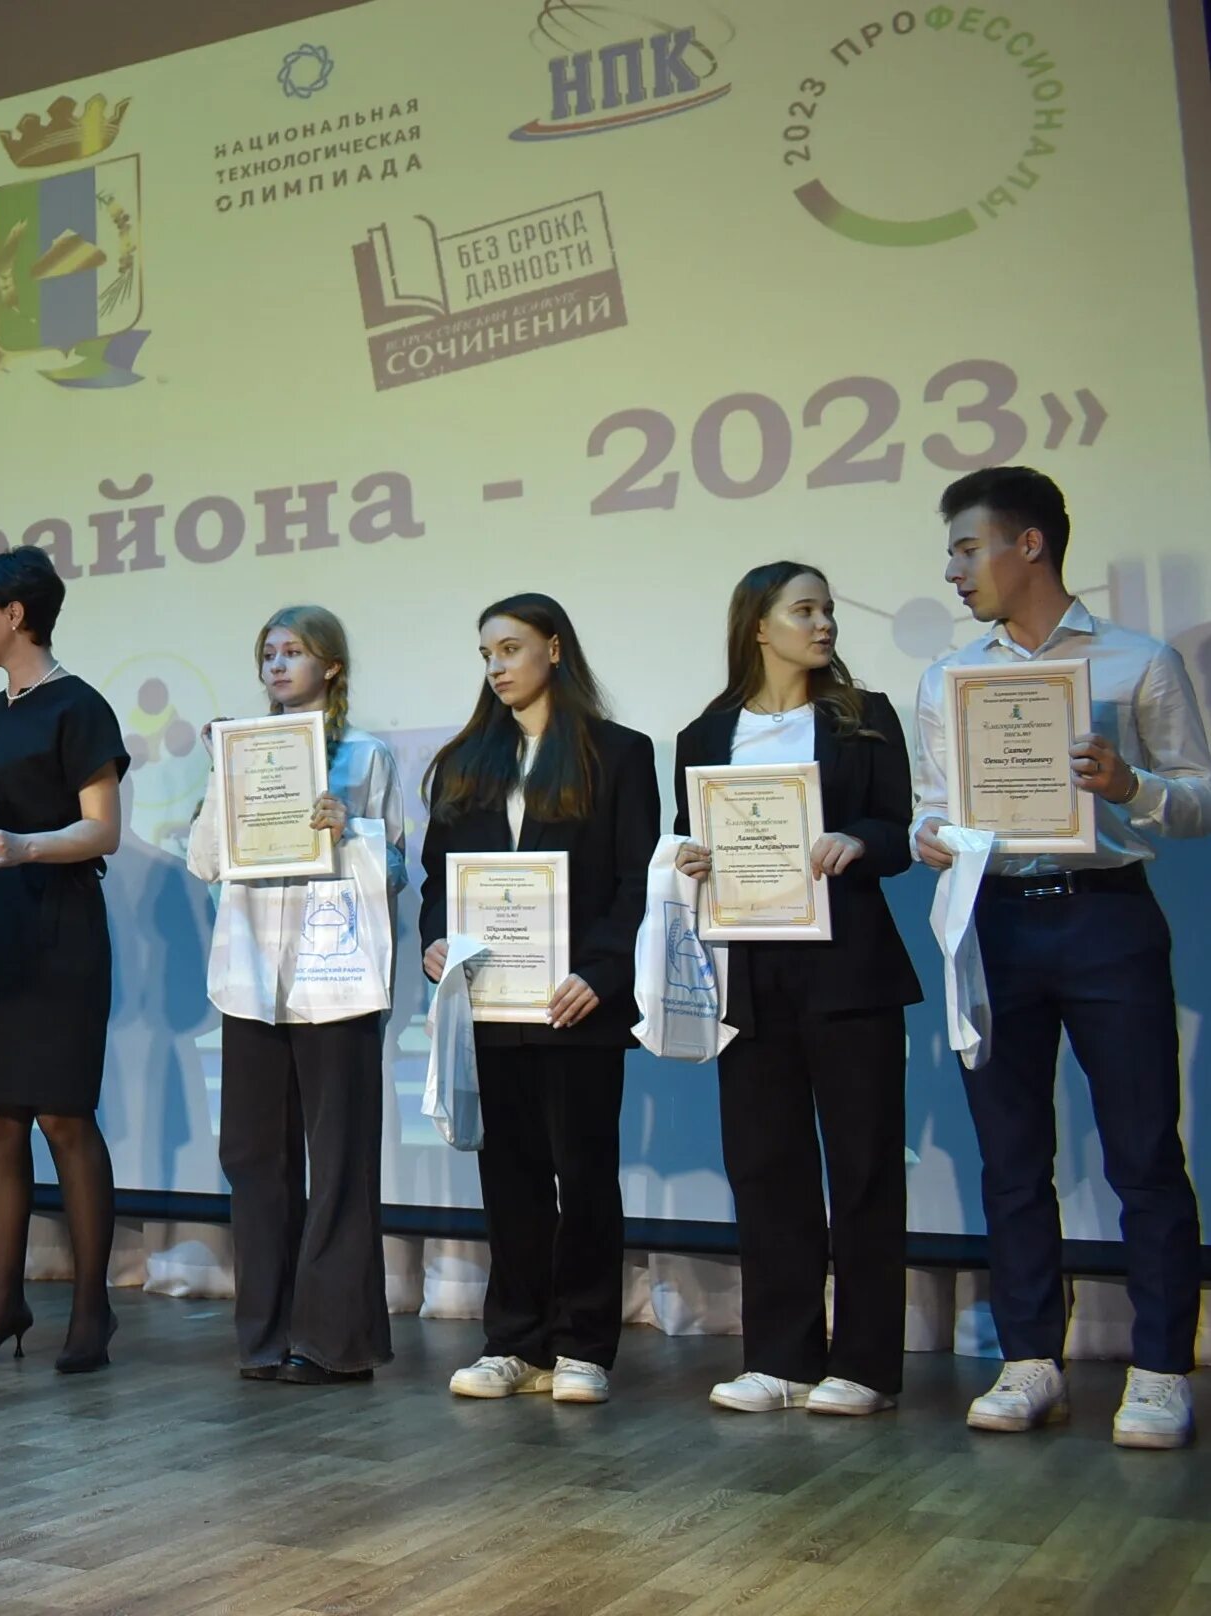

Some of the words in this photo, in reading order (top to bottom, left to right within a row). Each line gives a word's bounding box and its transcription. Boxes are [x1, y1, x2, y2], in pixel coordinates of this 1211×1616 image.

[549, 25, 700, 120] НПК
[214, 98, 419, 159] НАЦИОНАЛЬНАЯ
[783, 77, 826, 166] 2023
[830, 4, 1066, 219] ПРОФЕССИОНАЛЫ
[216, 125, 421, 184] ТЕХНОЛОГИЧЕСКАЯ
[216, 152, 422, 213] ОЛИМПИАДА
[457, 235, 500, 269] БЕЗ
[507, 209, 588, 254] СРОКА
[466, 240, 594, 302] ДАВНОСТИ
[387, 292, 611, 375] СОЧИНЕНИЙ
[586, 358, 1108, 516] 2023»
